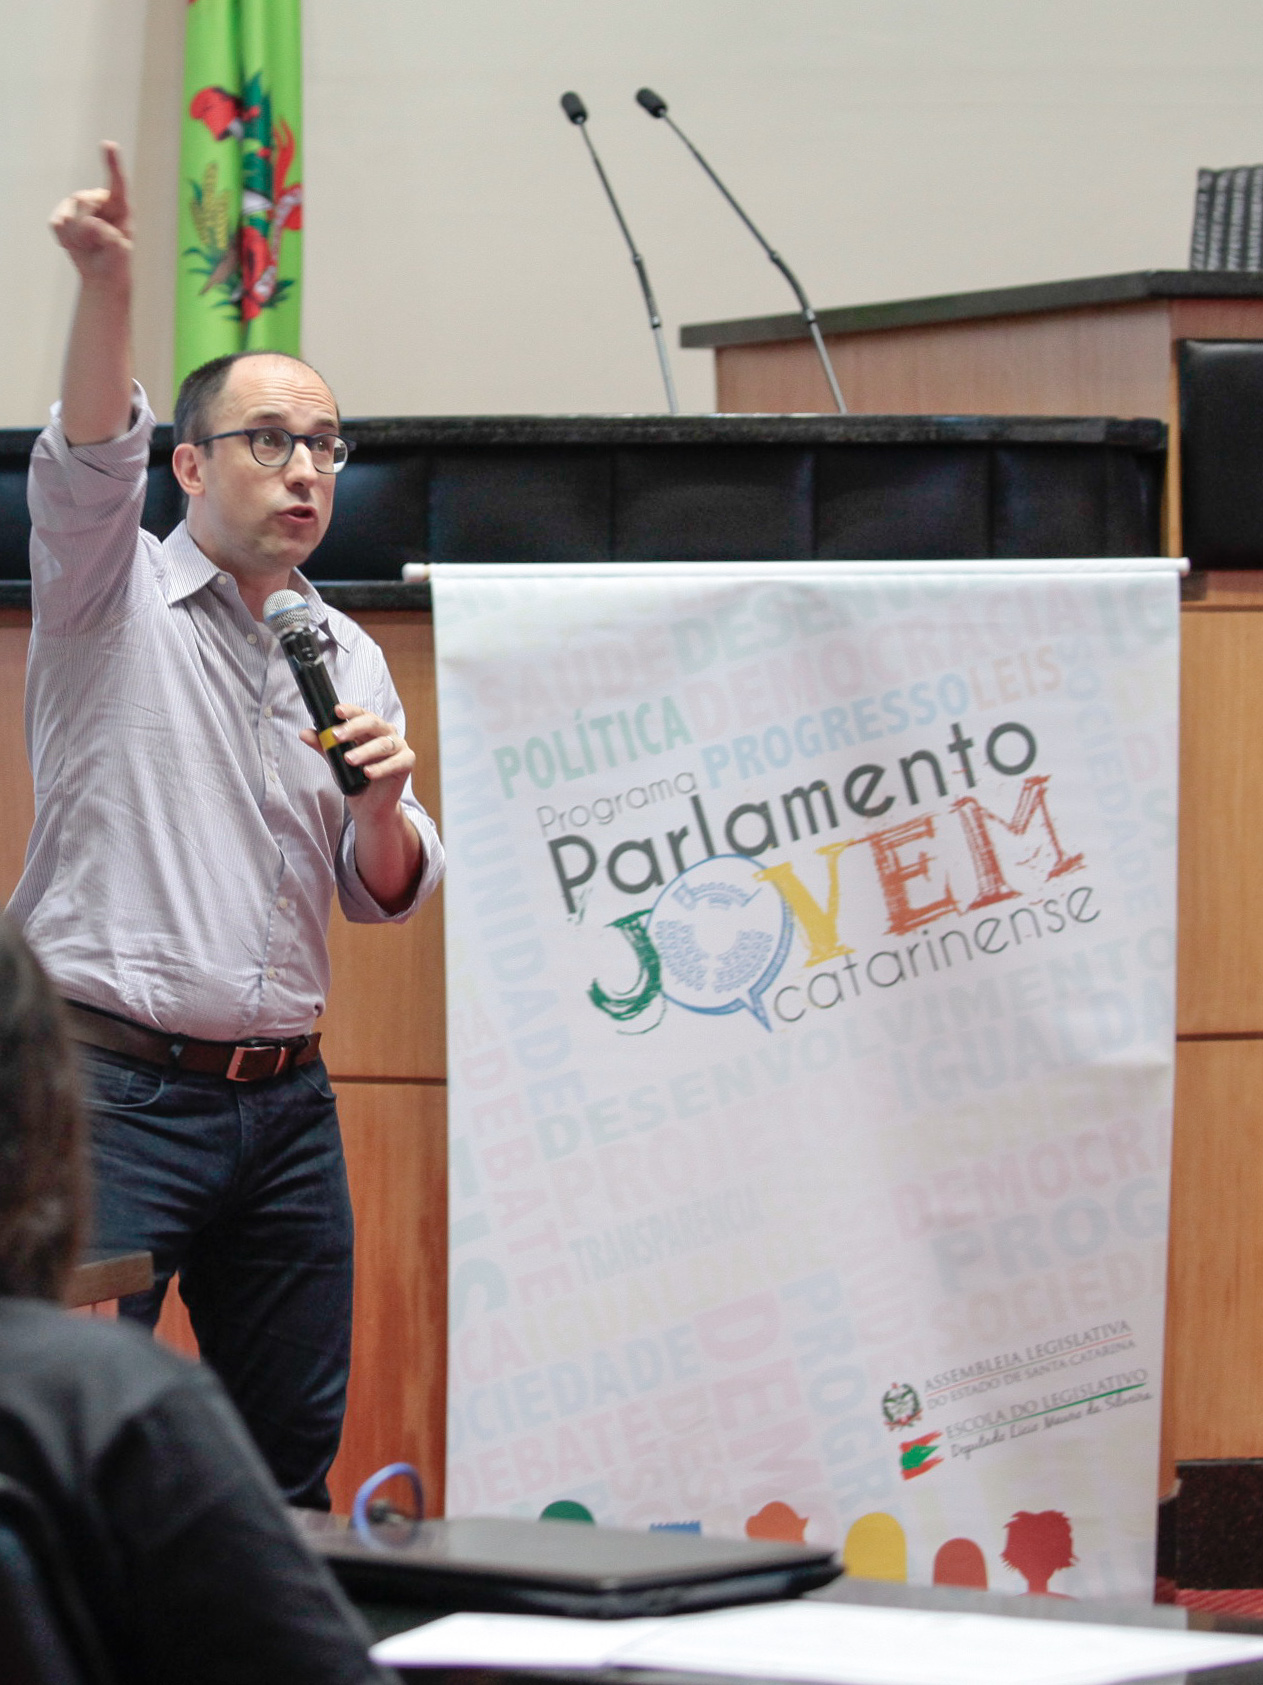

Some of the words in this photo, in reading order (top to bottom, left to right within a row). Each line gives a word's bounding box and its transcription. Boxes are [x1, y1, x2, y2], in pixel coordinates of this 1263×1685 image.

[681, 583, 1086, 741] DEMOCRACIA
[700, 673, 969, 789] PROGRESSO
[968, 645, 1063, 711] LEIS
[492, 695, 693, 799] POLÍTICA
[537, 771, 697, 838] Programa
[547, 721, 1038, 914] Parlamento
[587, 773, 1086, 1036] JOVEM
[773, 886, 1101, 1022] catarinense
[535, 926, 1172, 1162] DESENVOLVIMENTO
[924, 1352, 1022, 1393] ASSEMBLEIA
[1026, 1320, 1131, 1360] LEGISLATIVA
[945, 1410, 1007, 1440] ESCOLA
[1010, 1400, 1038, 1418] DO
[1041, 1368, 1148, 1409] LEGISLATIVO
